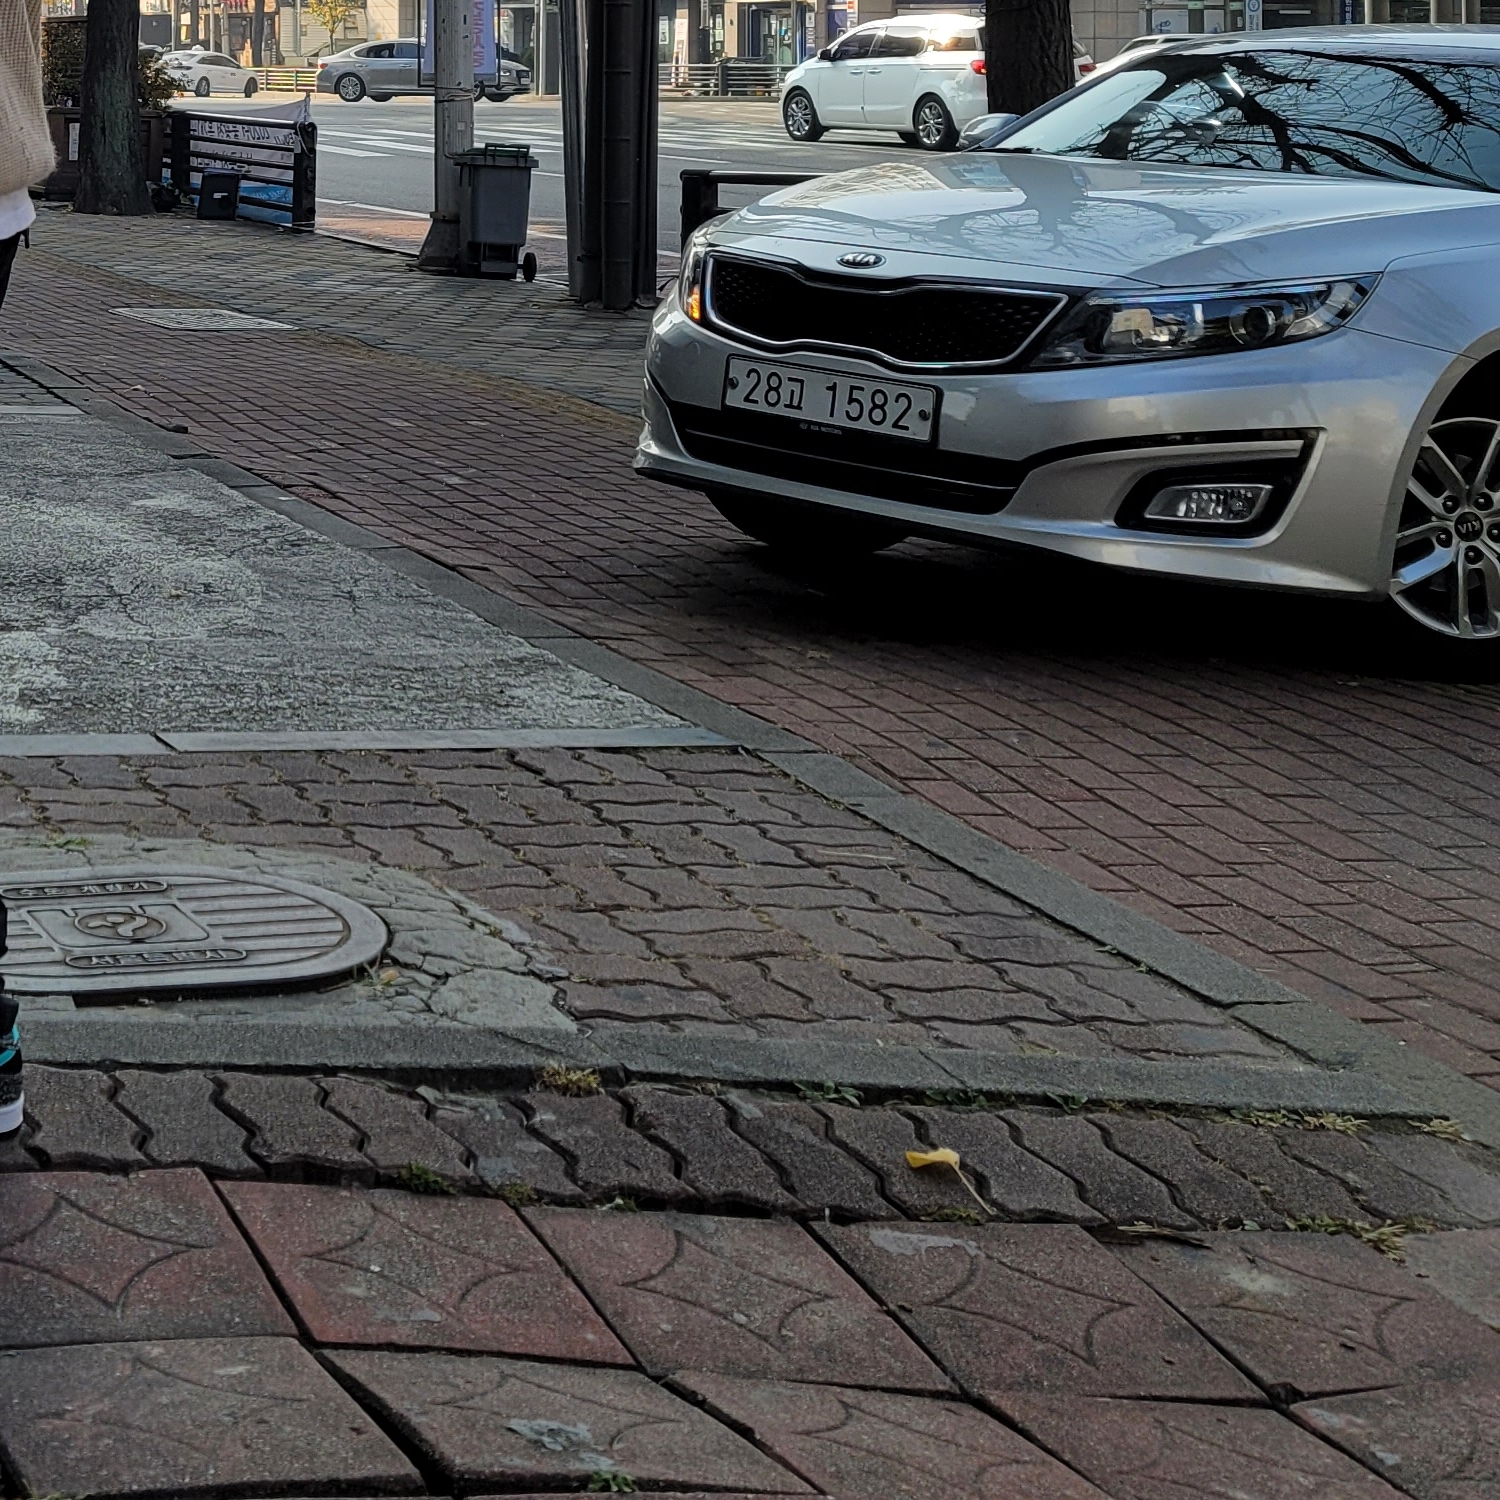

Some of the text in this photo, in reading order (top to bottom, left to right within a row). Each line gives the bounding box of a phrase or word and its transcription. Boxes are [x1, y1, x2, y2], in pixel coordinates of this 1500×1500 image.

[839, 252, 877, 265] KIA
[743, 367, 913, 431] 28고 1582
